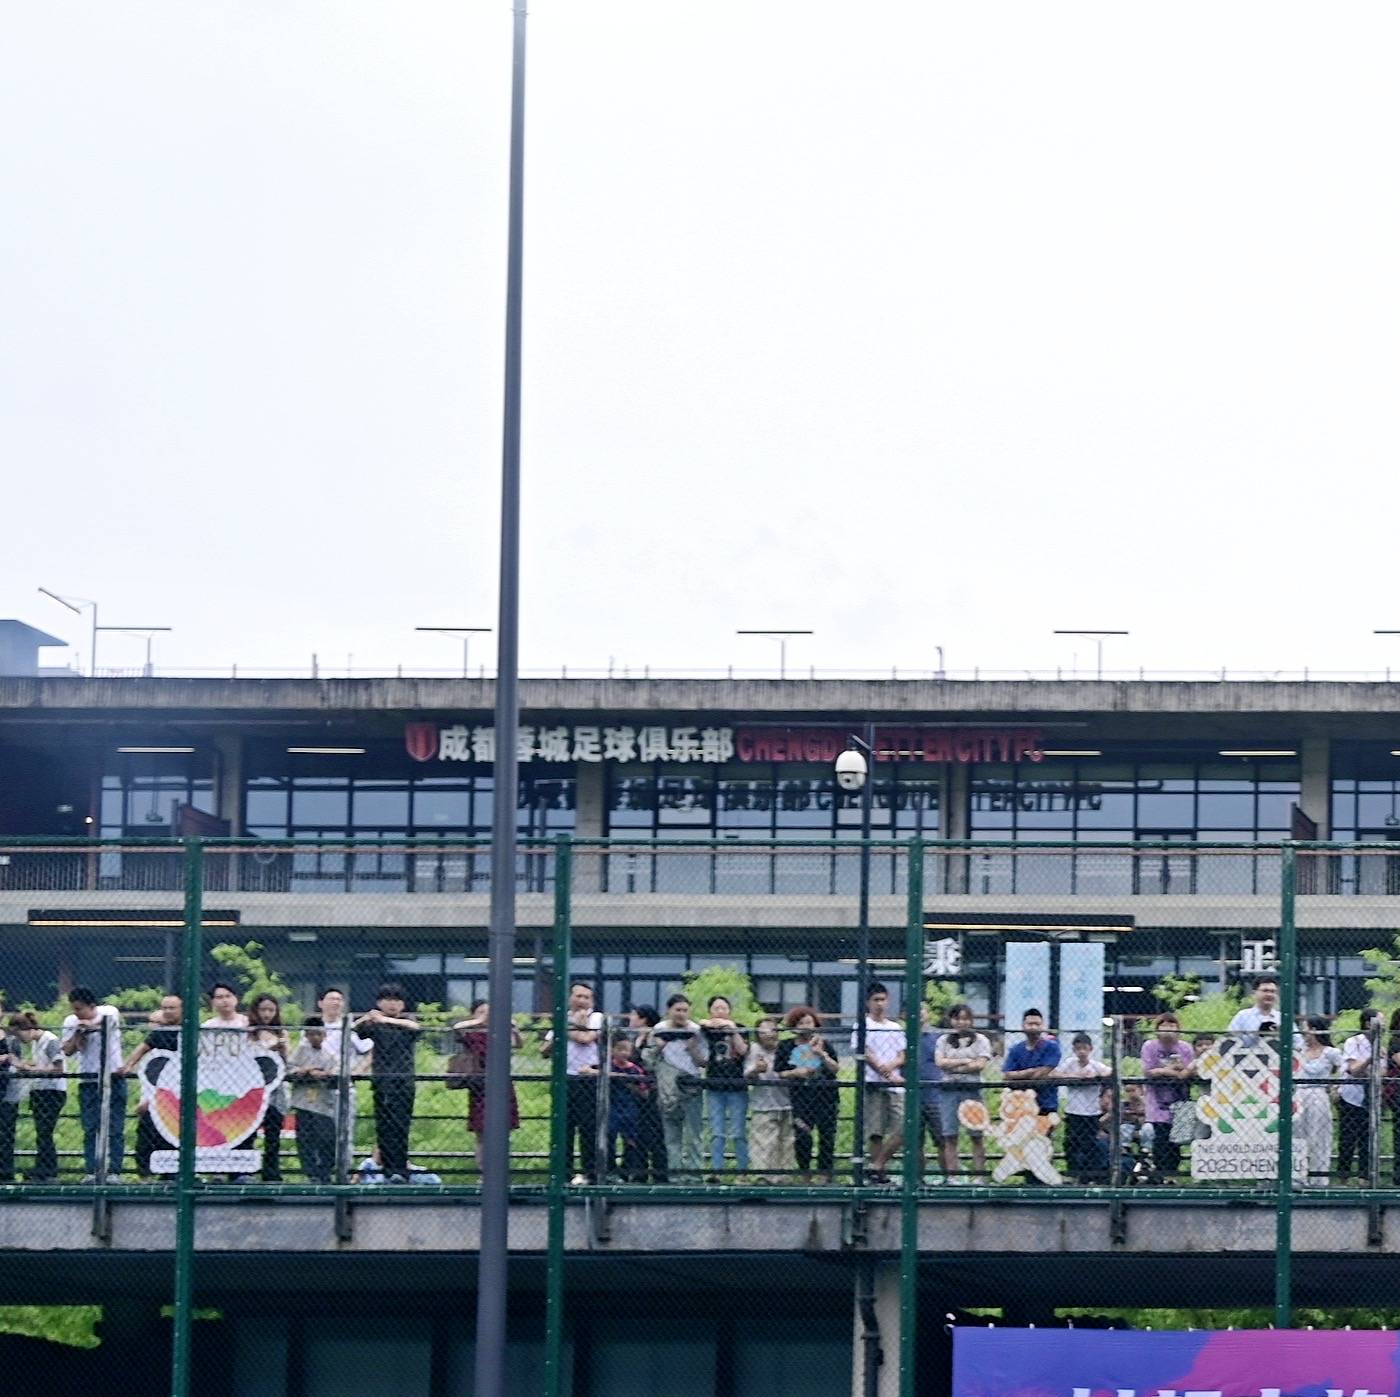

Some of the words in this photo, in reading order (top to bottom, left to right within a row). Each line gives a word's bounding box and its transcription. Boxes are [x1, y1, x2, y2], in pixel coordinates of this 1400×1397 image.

[439, 724, 735, 763] 成都蓉城足球俱乐部
[1197, 1158, 1238, 1173] 2025
[1240, 1158, 1302, 1173] CHENU
